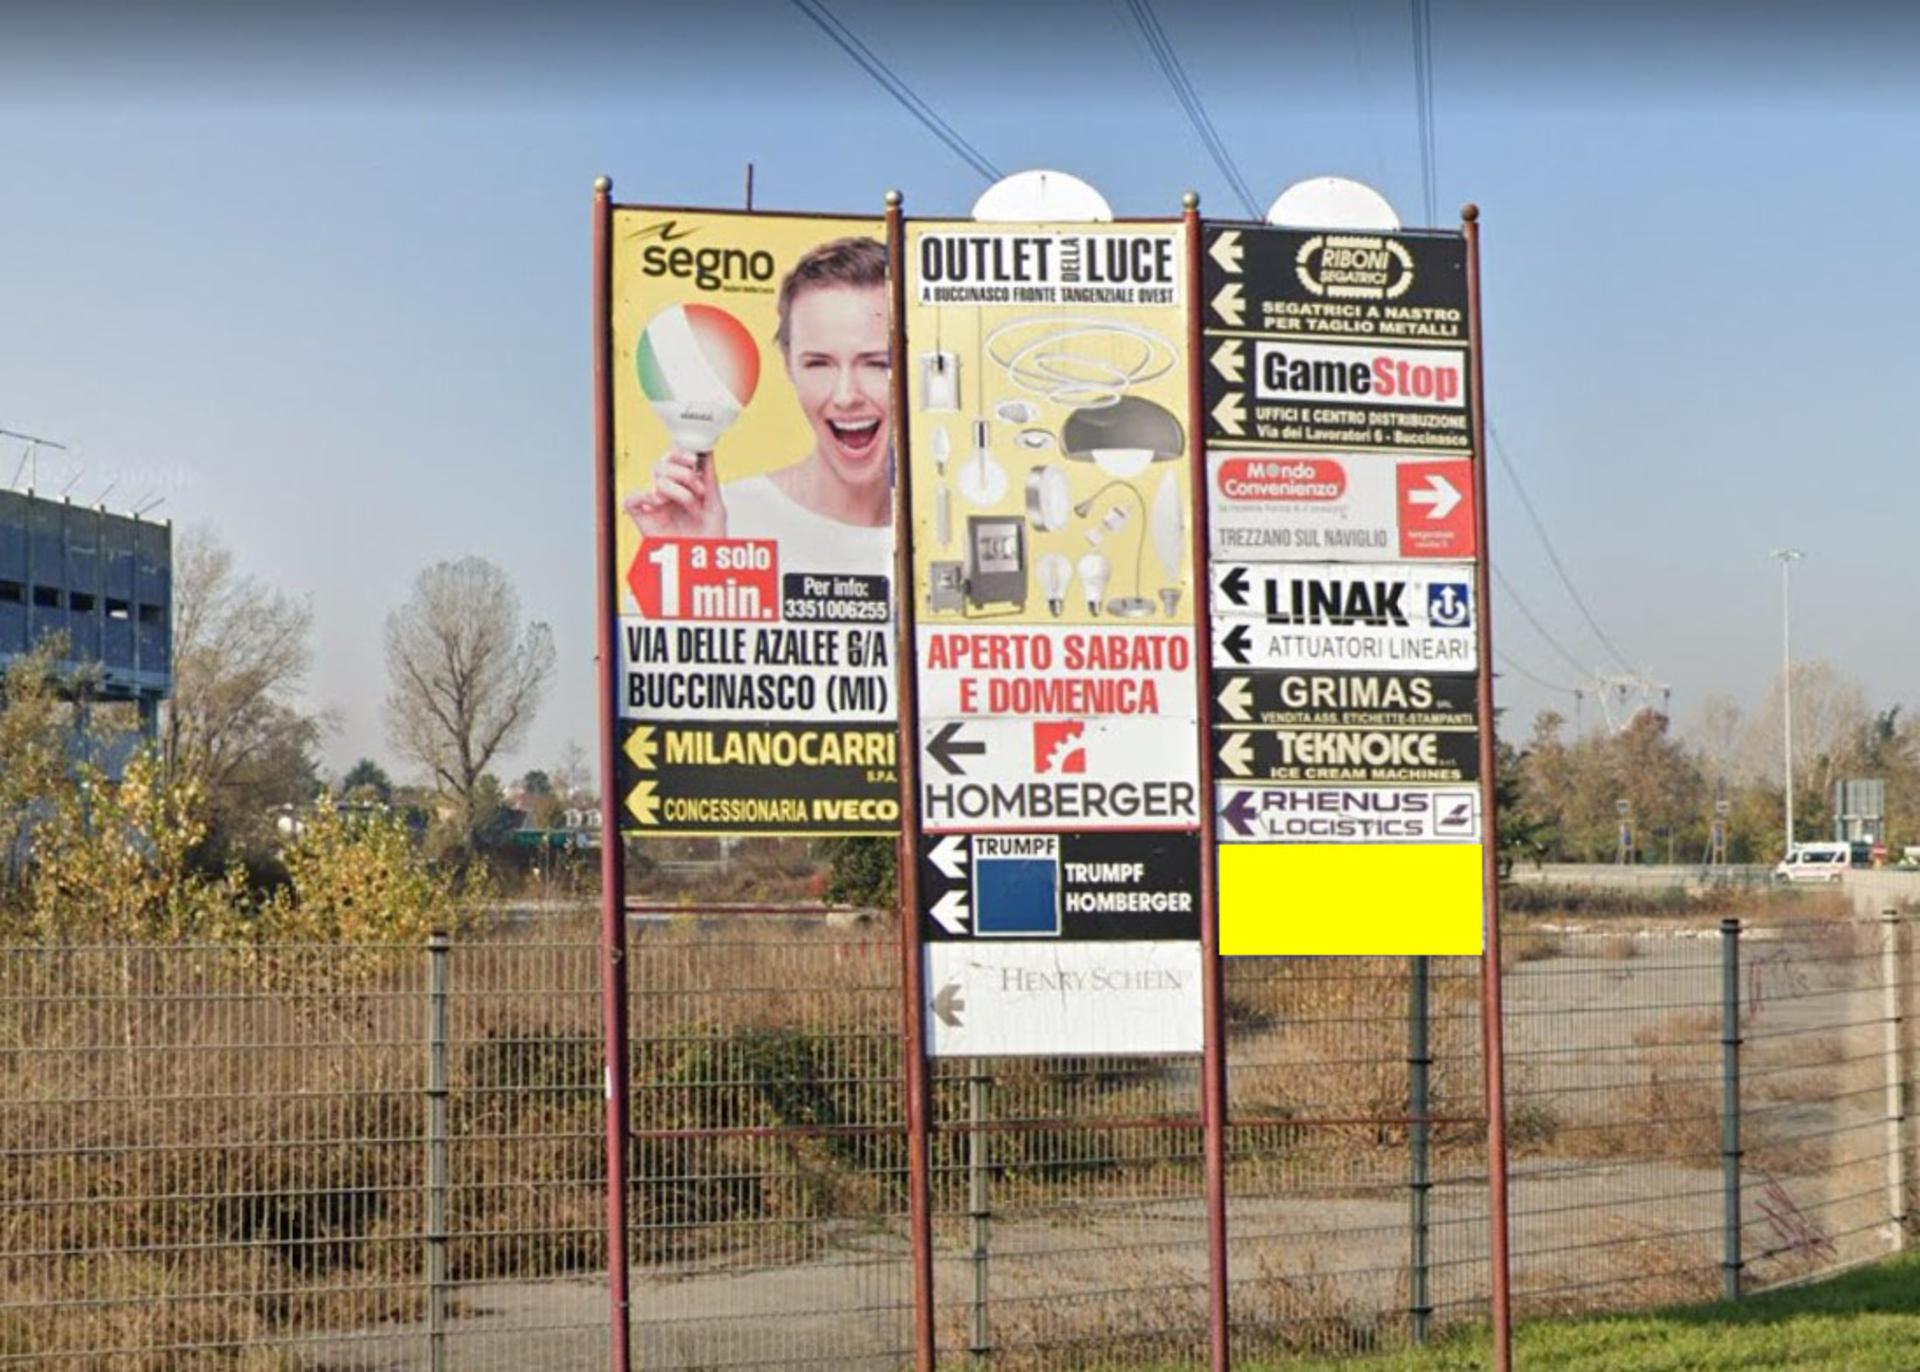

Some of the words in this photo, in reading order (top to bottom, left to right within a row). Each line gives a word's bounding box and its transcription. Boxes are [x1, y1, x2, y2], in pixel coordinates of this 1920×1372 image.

[642, 244, 775, 291] segno
[921, 237, 1053, 283] OUTLET
[1060, 237, 1081, 283] DELLA
[1086, 238, 1173, 284] LUCE
[1321, 250, 1390, 270] RIBONI
[1320, 270, 1388, 285] SEGATRICI
[923, 286, 931, 301] A
[934, 286, 1010, 302] BUCCINASCO
[1013, 287, 1056, 303] FRONTE
[1061, 287, 1134, 303] TANGENZIALE
[1138, 288, 1174, 304] OVEST
[1262, 301, 1362, 317] SEGATRICI
[1367, 306, 1380, 318] A
[1385, 307, 1461, 322] NASTRO
[1264, 316, 1301, 330] PER
[1306, 318, 1374, 333] TAGLIO
[1380, 321, 1458, 336] METALLI
[1263, 351, 1459, 402] GameStop
[1255, 406, 1299, 421] UFFICI
[1302, 409, 1310, 422] E
[1313, 408, 1366, 425] CENTRO
[1369, 411, 1467, 430] DISTRIBUZIONE
[1256, 424, 1279, 438] Via
[1282, 425, 1302, 440] dei
[1306, 425, 1372, 443] Lavoratori
[1394, 430, 1468, 447] Buccinasco
[1225, 479, 1339, 498] Convenienza
[1219, 528, 1292, 548] TREZZANO
[1295, 528, 1321, 548] SUL
[1324, 529, 1388, 548] NAVIGLIO
[691, 544, 708, 569] a
[715, 542, 771, 570] solo
[648, 543, 682, 618] 1
[803, 576, 831, 597] Per
[833, 577, 869, 598] info:
[691, 578, 774, 619] min.
[784, 598, 888, 620] 3351006255
[1265, 578, 1410, 627] LINAK
[627, 626, 669, 664] VIA
[678, 627, 747, 664] DELLE
[753, 628, 840, 666] AZALEE
[846, 630, 889, 668] 6/A
[927, 633, 1053, 671] APERTO
[1063, 634, 1190, 672] SABATO
[1268, 634, 1383, 659] ATTUATORI
[1390, 637, 1470, 660] LINEARI
[628, 671, 816, 711] BUCCINASCO
[826, 674, 889, 714] (MI)
[959, 677, 978, 713] E
[988, 677, 1160, 715] DOMENICA
[1280, 675, 1433, 709] GRIMAS
[1260, 711, 1311, 724] VENDITA
[665, 730, 897, 767] MILANOCARRI
[1276, 731, 1438, 765] TEKNOICE
[1271, 767, 1300, 779] ICE
[1304, 767, 1368, 780] CREAM
[1371, 768, 1462, 781] MACHINES
[664, 798, 809, 823] CONCESSIONARIA
[812, 799, 900, 821] IVECO
[925, 781, 1196, 819] HOMBERGER
[1262, 790, 1429, 812] RHENUS
[1269, 818, 1423, 837] LOGISTICS
[975, 837, 1057, 856] TRUMPF
[1064, 862, 1146, 883] TRUMPF
[1065, 891, 1193, 913] HOMBERGER
